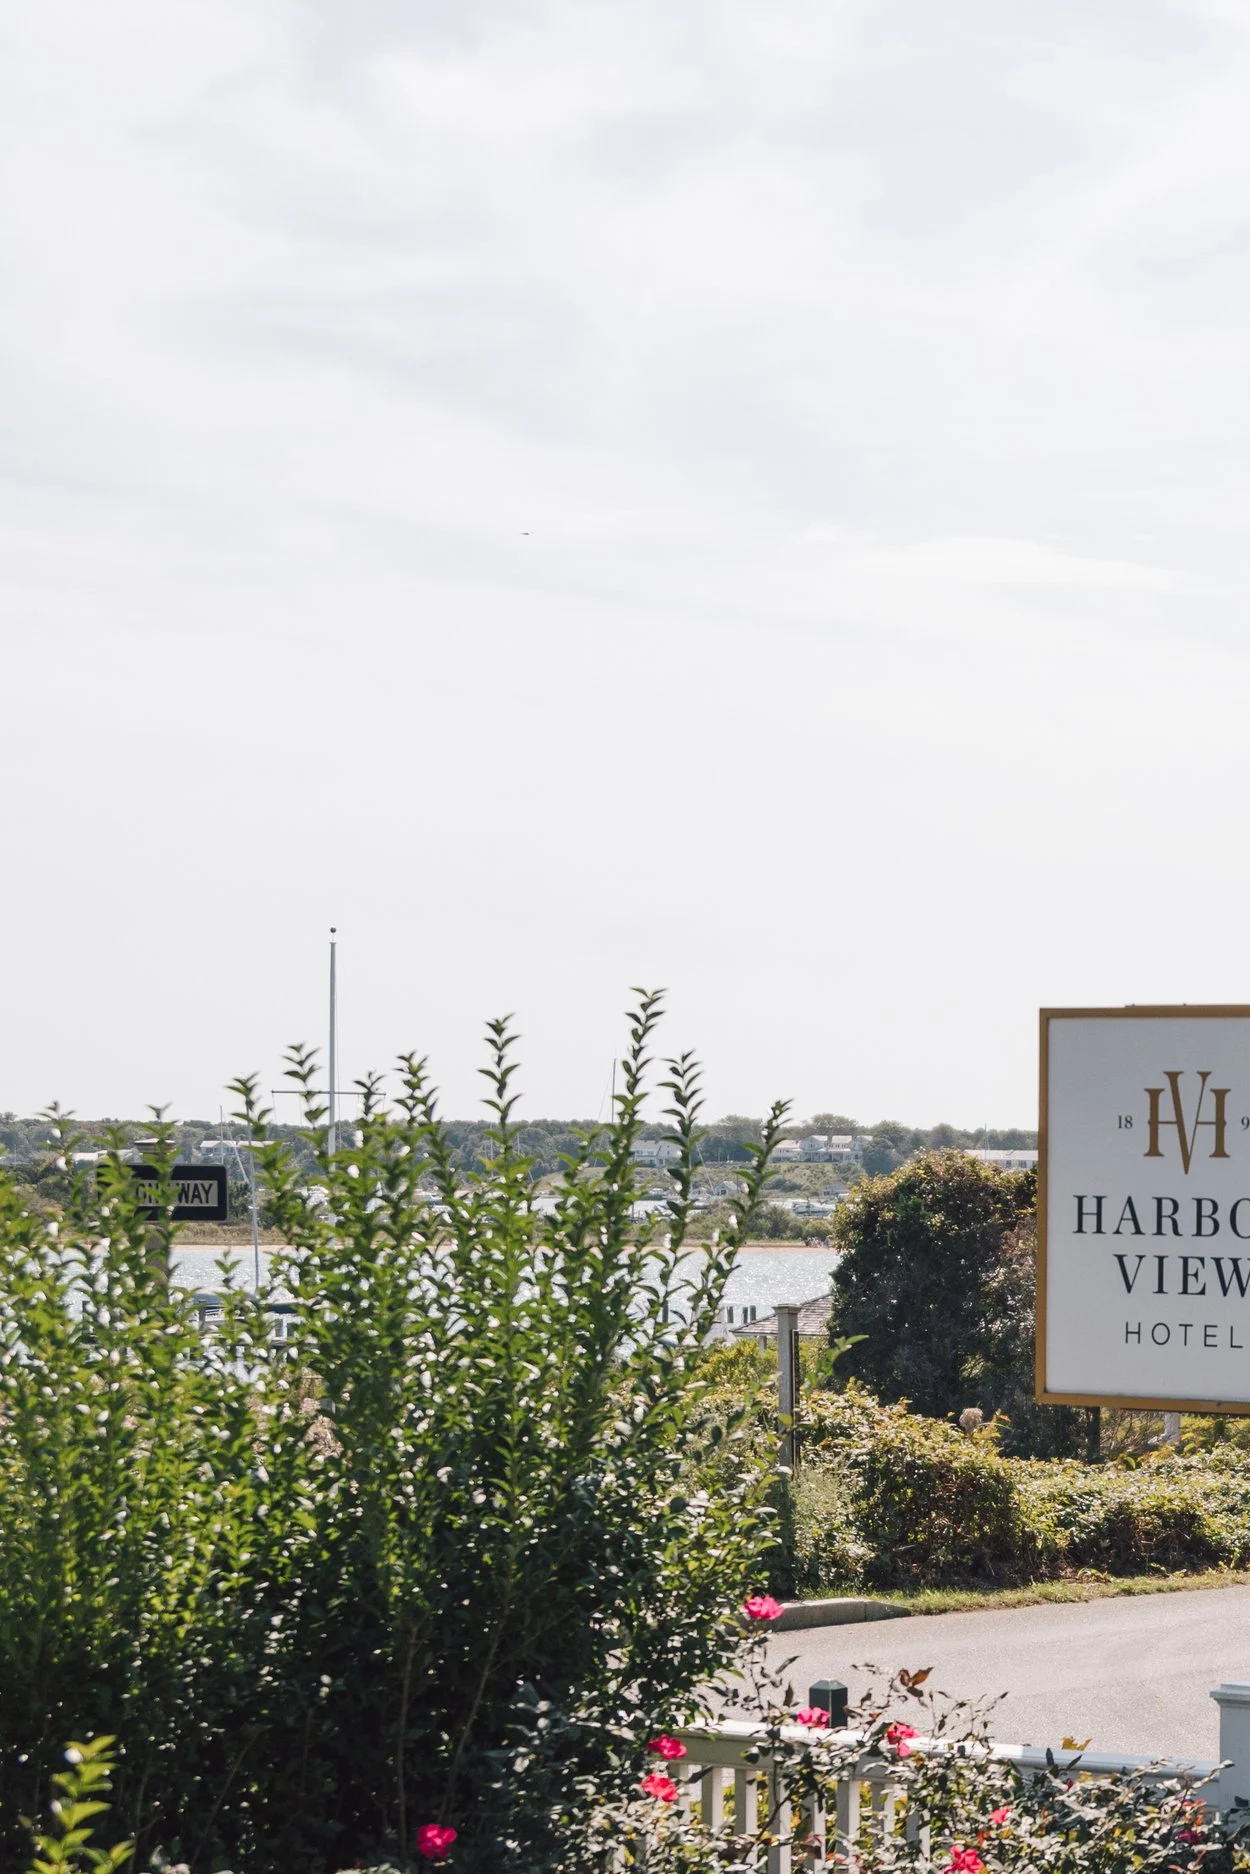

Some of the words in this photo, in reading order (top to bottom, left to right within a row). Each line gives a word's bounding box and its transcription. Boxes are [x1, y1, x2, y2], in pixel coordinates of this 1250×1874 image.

[1117, 1114, 1134, 1130] 18
[176, 1182, 214, 1204] WAY
[1125, 1321, 1244, 1349] HOTEL
